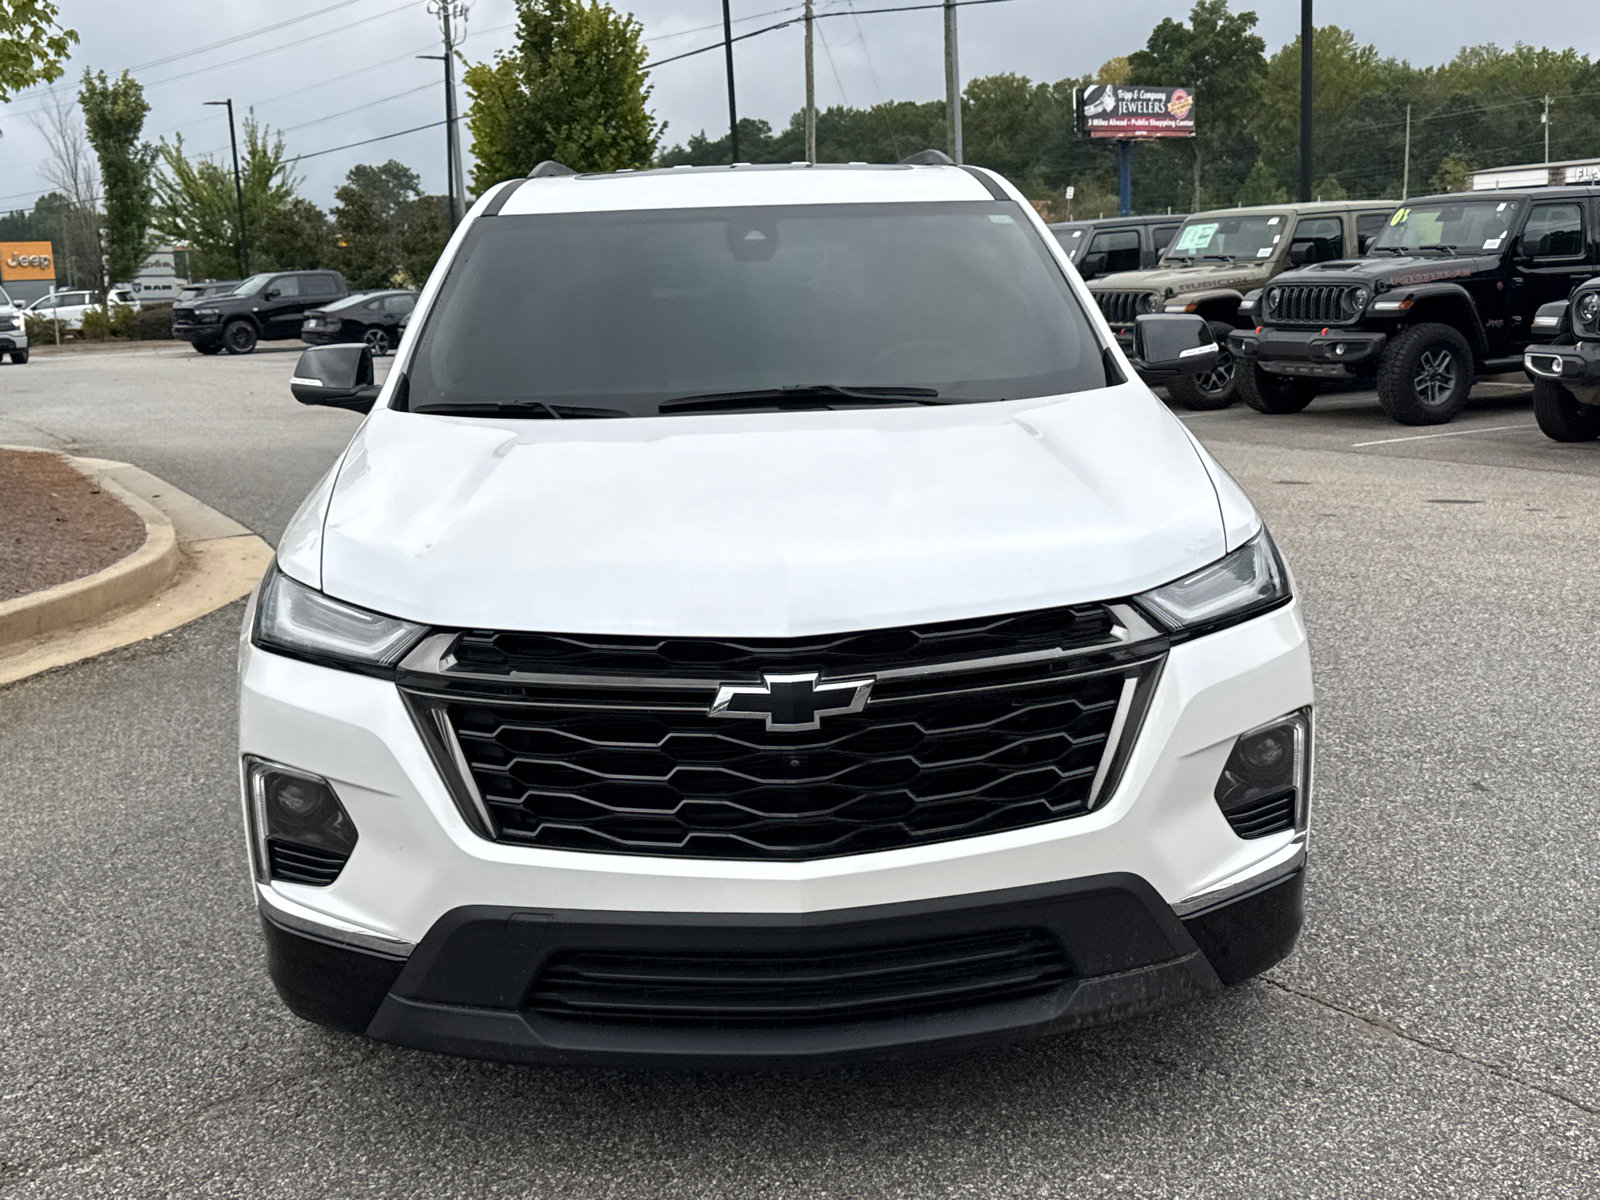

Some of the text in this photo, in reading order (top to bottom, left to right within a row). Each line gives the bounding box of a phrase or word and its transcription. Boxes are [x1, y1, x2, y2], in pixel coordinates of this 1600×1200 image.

[1140, 89, 1166, 102] Company
[1118, 101, 1166, 115] JEWELERS
[1109, 118, 1128, 126] Ahead
[1150, 118, 1176, 128] Shopping
[6, 251, 51, 270] Jeep
[1178, 276, 1249, 291] RUBICON
[1485, 317, 1504, 328] Jeep
